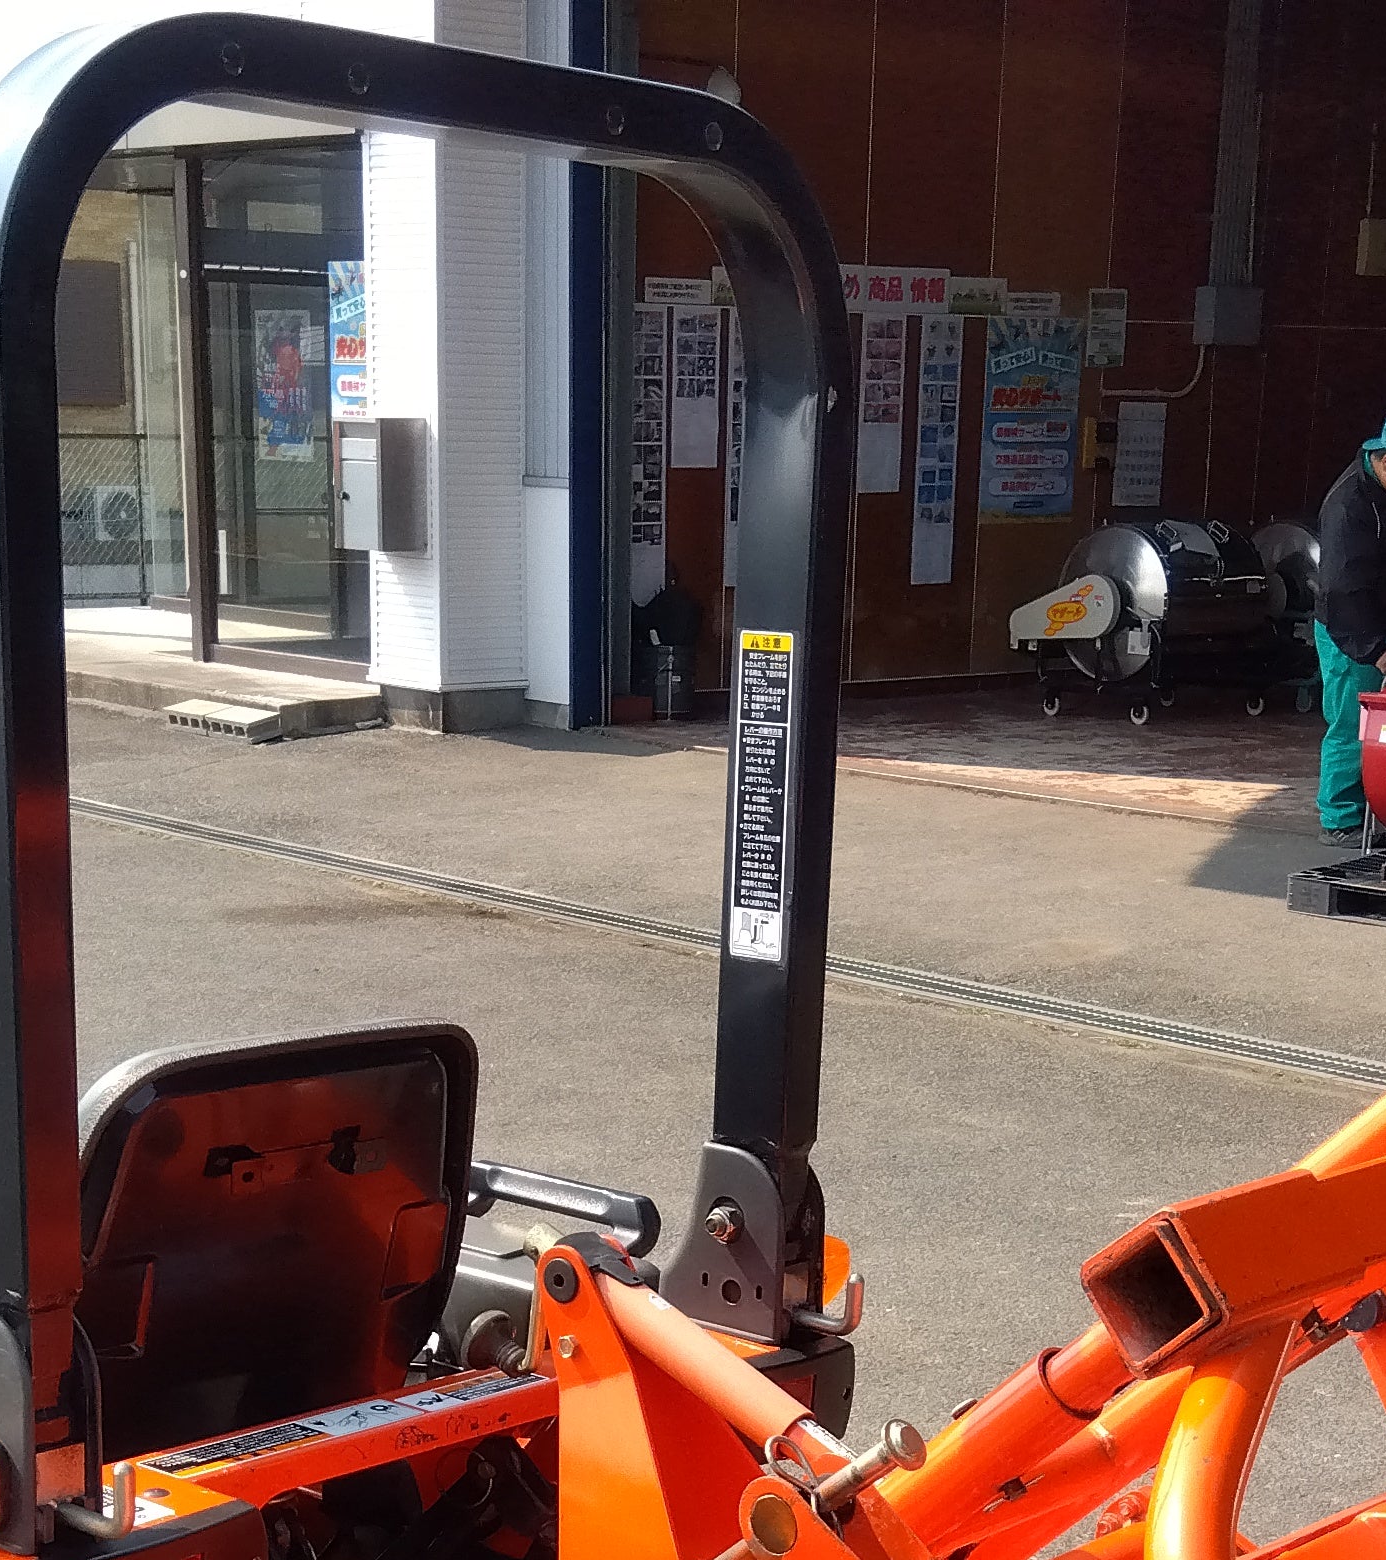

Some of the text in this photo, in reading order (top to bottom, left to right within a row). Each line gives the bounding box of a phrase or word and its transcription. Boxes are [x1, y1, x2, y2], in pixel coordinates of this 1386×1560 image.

[868, 276, 904, 302] 商品
[910, 276, 946, 304] 情報
[762, 637, 782, 649] 注意
